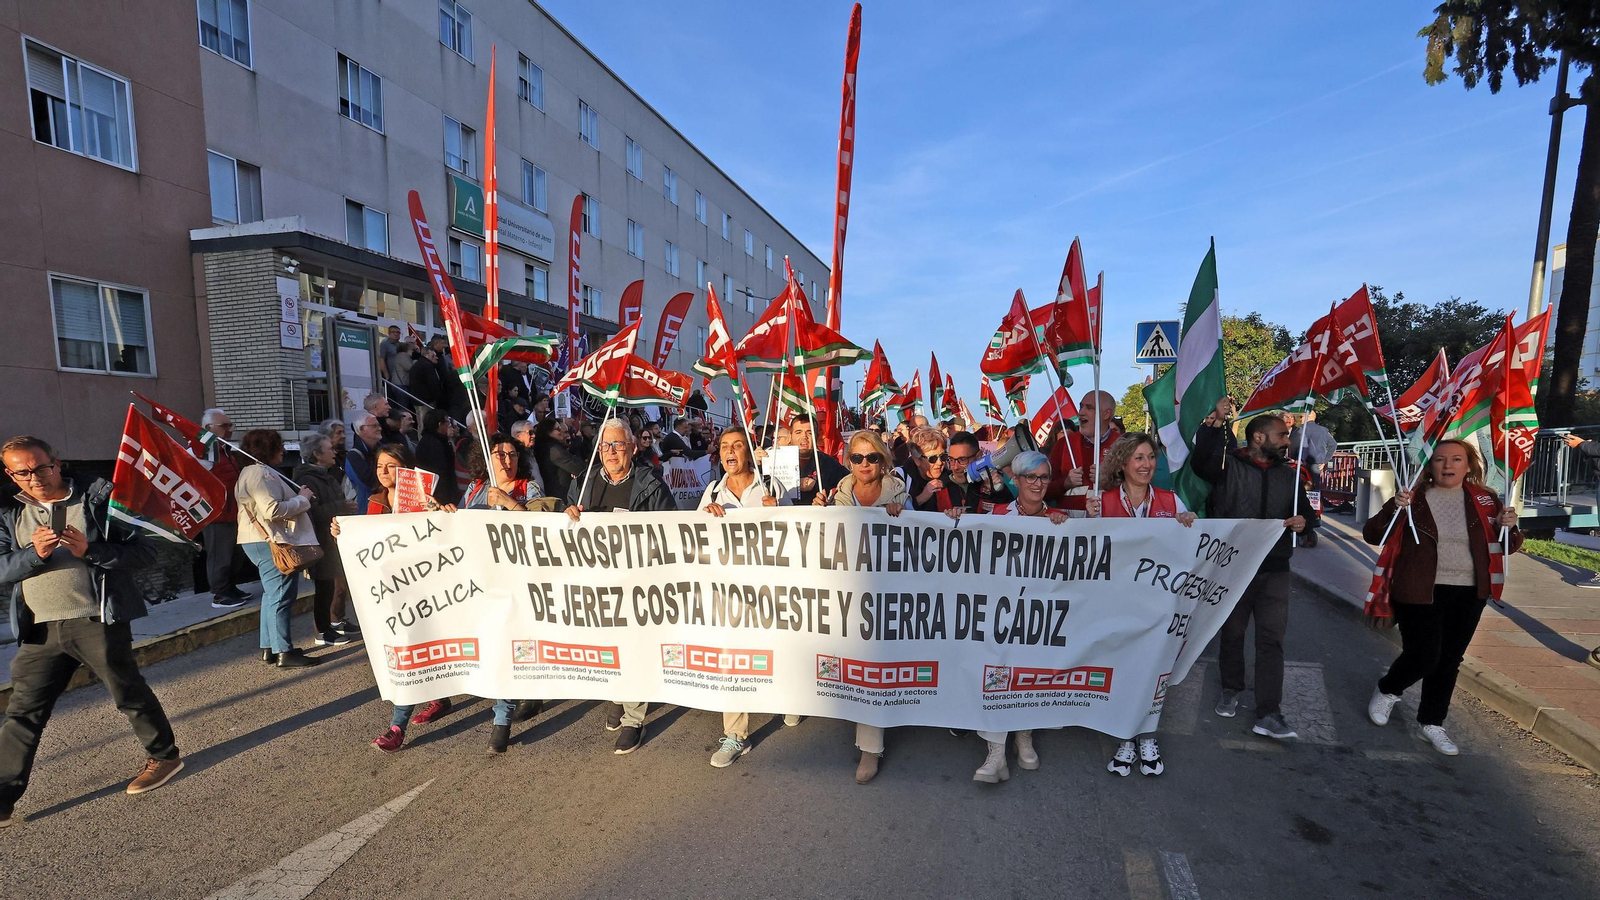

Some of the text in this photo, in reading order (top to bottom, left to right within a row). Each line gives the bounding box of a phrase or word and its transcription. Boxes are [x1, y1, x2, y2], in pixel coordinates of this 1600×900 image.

[355, 518, 442, 568] POR LA
[485, 519, 1112, 581] POR EL HOSPITAL DE JEREZ Y LA ATENCIÓN PRIMARIA
[370, 546, 465, 604] SANIDAD
[385, 579, 484, 635] PÚBLICA
[527, 581, 1070, 647] DE JEREZ COSTA NOROESTE Y SIERRA DE CÁDIZ
[397, 643, 461, 666] CCOO
[542, 645, 600, 663] CCOO
[690, 650, 750, 670] CCOO
[406, 670, 416, 678] de
[418, 664, 447, 675] sanidad
[593, 668, 622, 676] sectores
[663, 669, 696, 678] federación
[697, 672, 705, 680] de
[706, 674, 733, 682] sanidad
[740, 676, 773, 684] sectores
[847, 664, 915, 683] CCOO
[1017, 671, 1087, 686] CCOO
[664, 678, 709, 689] sociosanitarios
[710, 683, 719, 691] de
[816, 681, 854, 692] federación
[856, 687, 865, 695] de
[866, 689, 896, 697] sanidad
[816, 690, 871, 705] sociosanitarios
[872, 699, 882, 707] de
[983, 692, 1022, 701] federación
[1035, 691, 1066, 699] sanidad
[1074, 691, 1109, 701] sectores
[983, 701, 1039, 710] sociosanitarios
